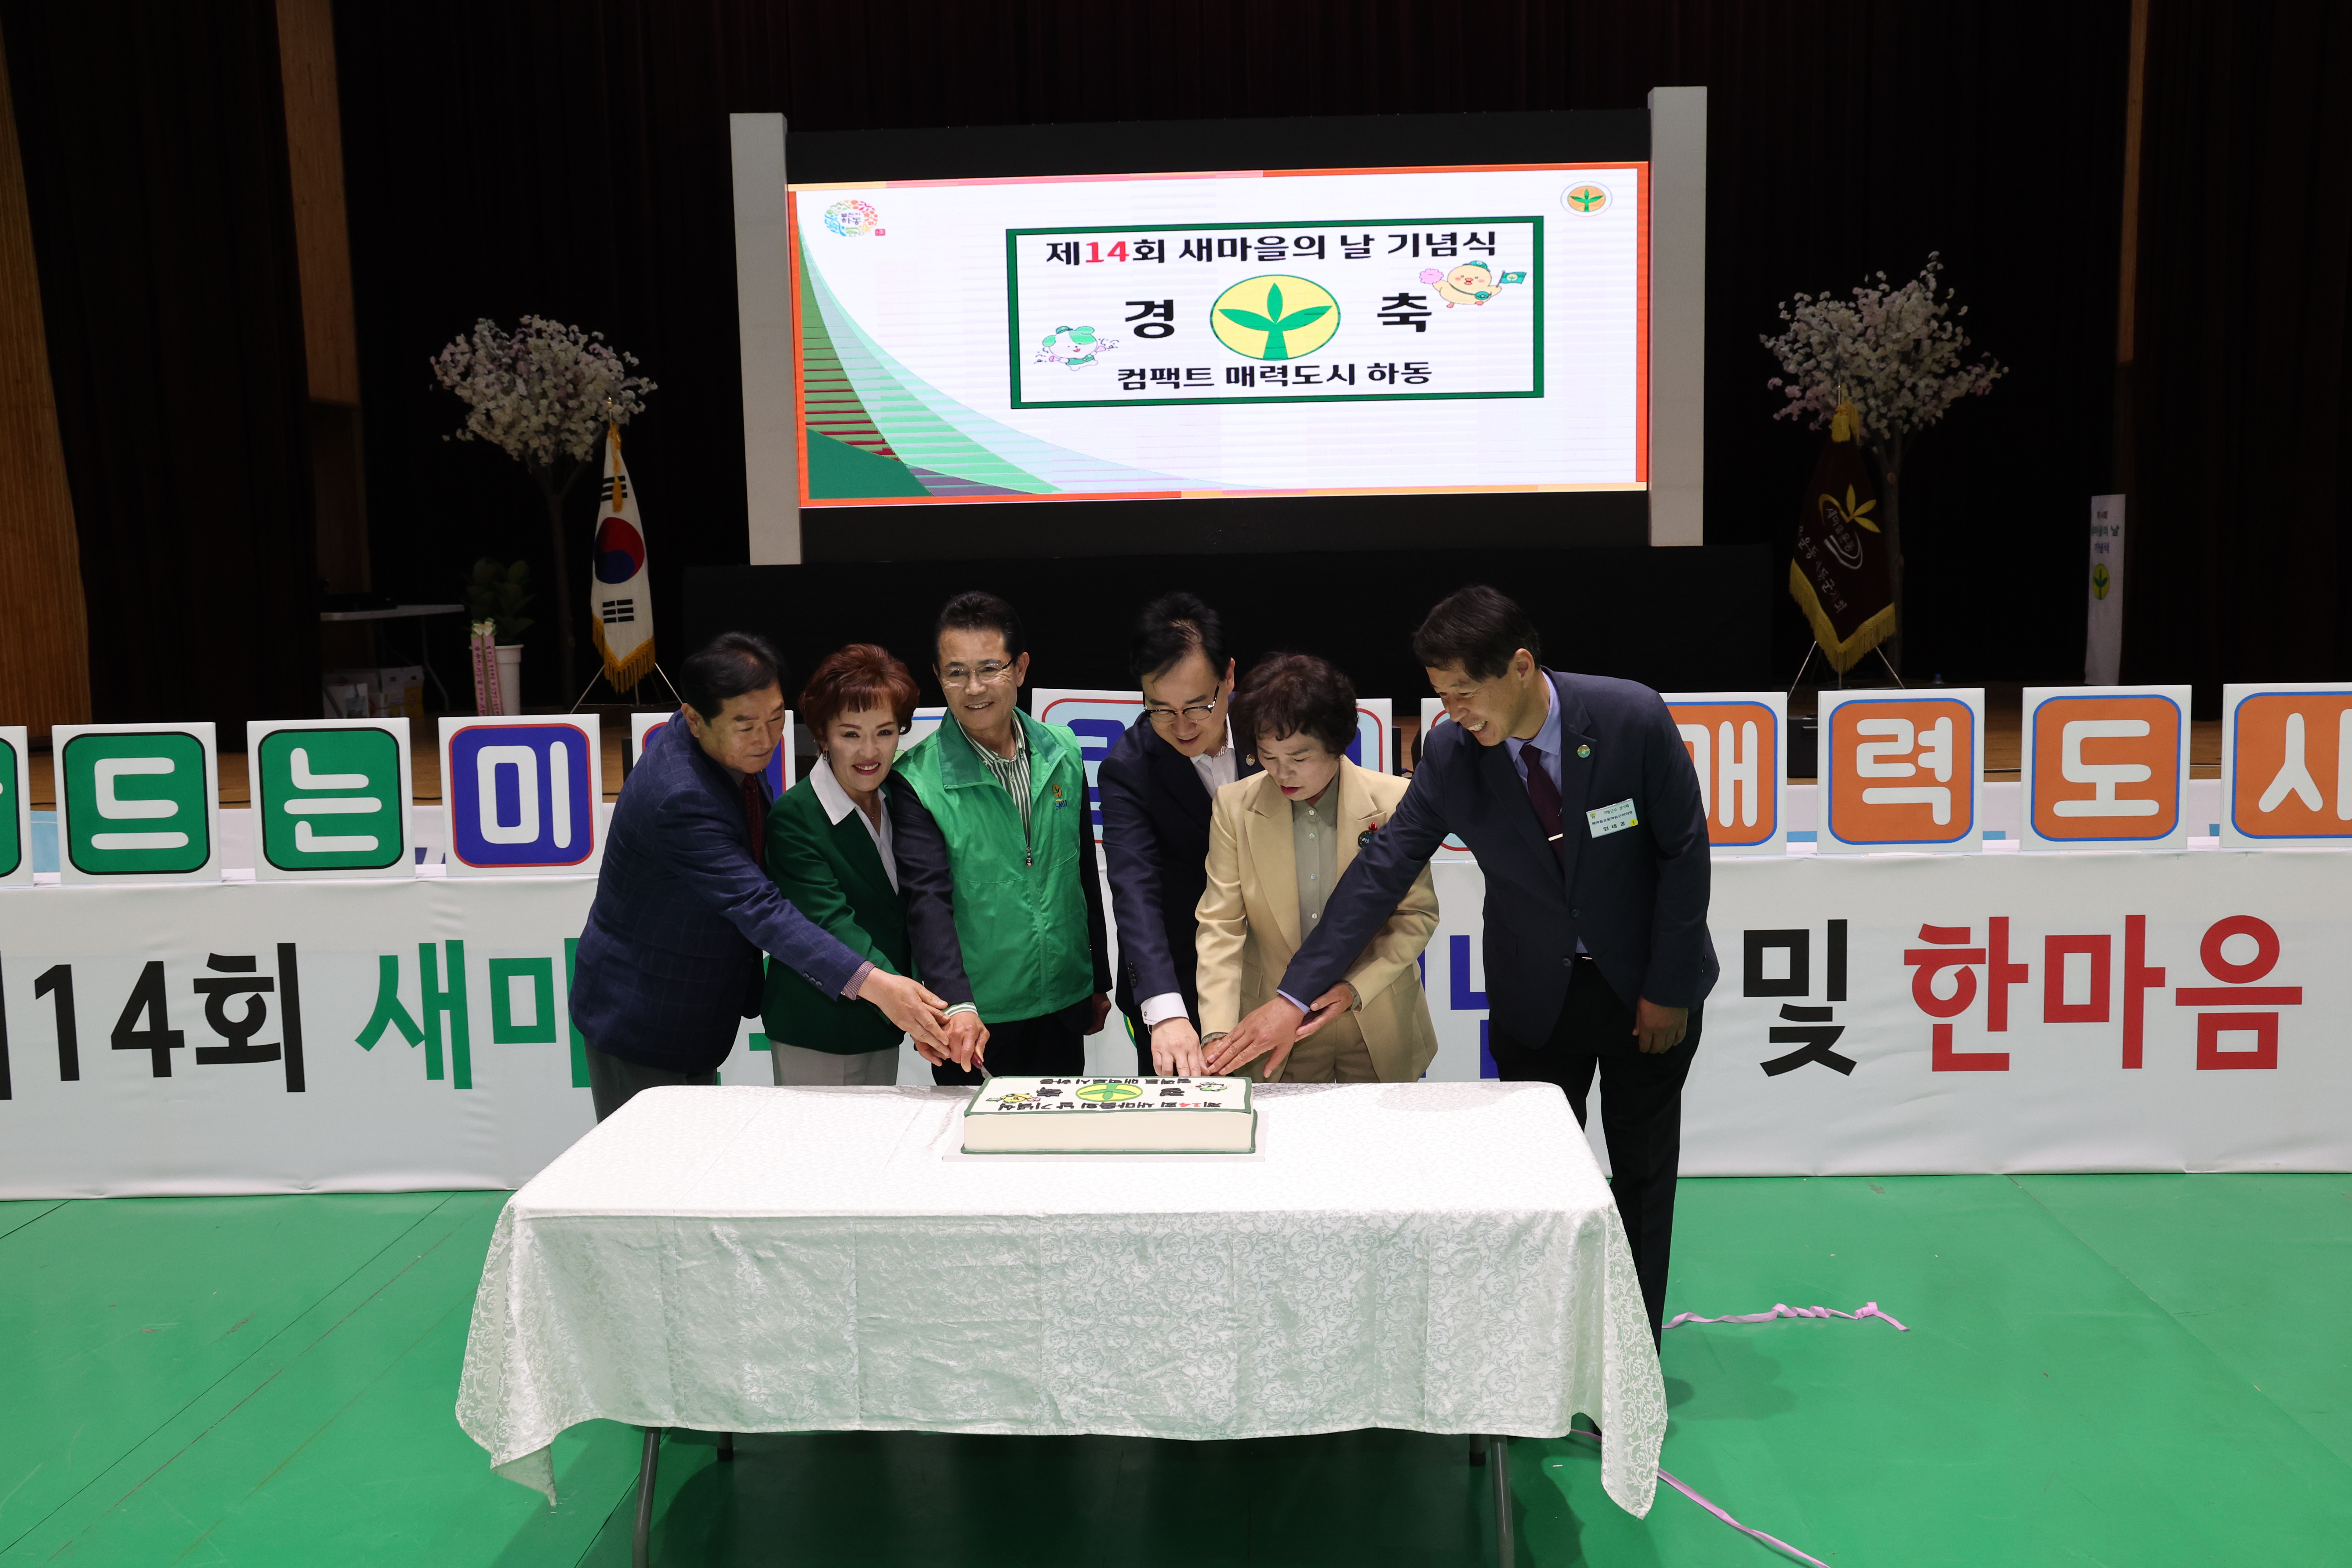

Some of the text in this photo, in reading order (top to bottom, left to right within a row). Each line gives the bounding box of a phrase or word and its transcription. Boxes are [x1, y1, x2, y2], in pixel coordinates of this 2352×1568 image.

[1046, 231, 1495, 265] 제14회 새마을의 날 기념식
[1125, 292, 1432, 339] 경 축
[1118, 362, 1432, 390] 컴팩트 매력도시 하동
[0, 747, 382, 853] 드는
[1743, 911, 1857, 1077] 및
[1904, 915, 2303, 1072] 한마음
